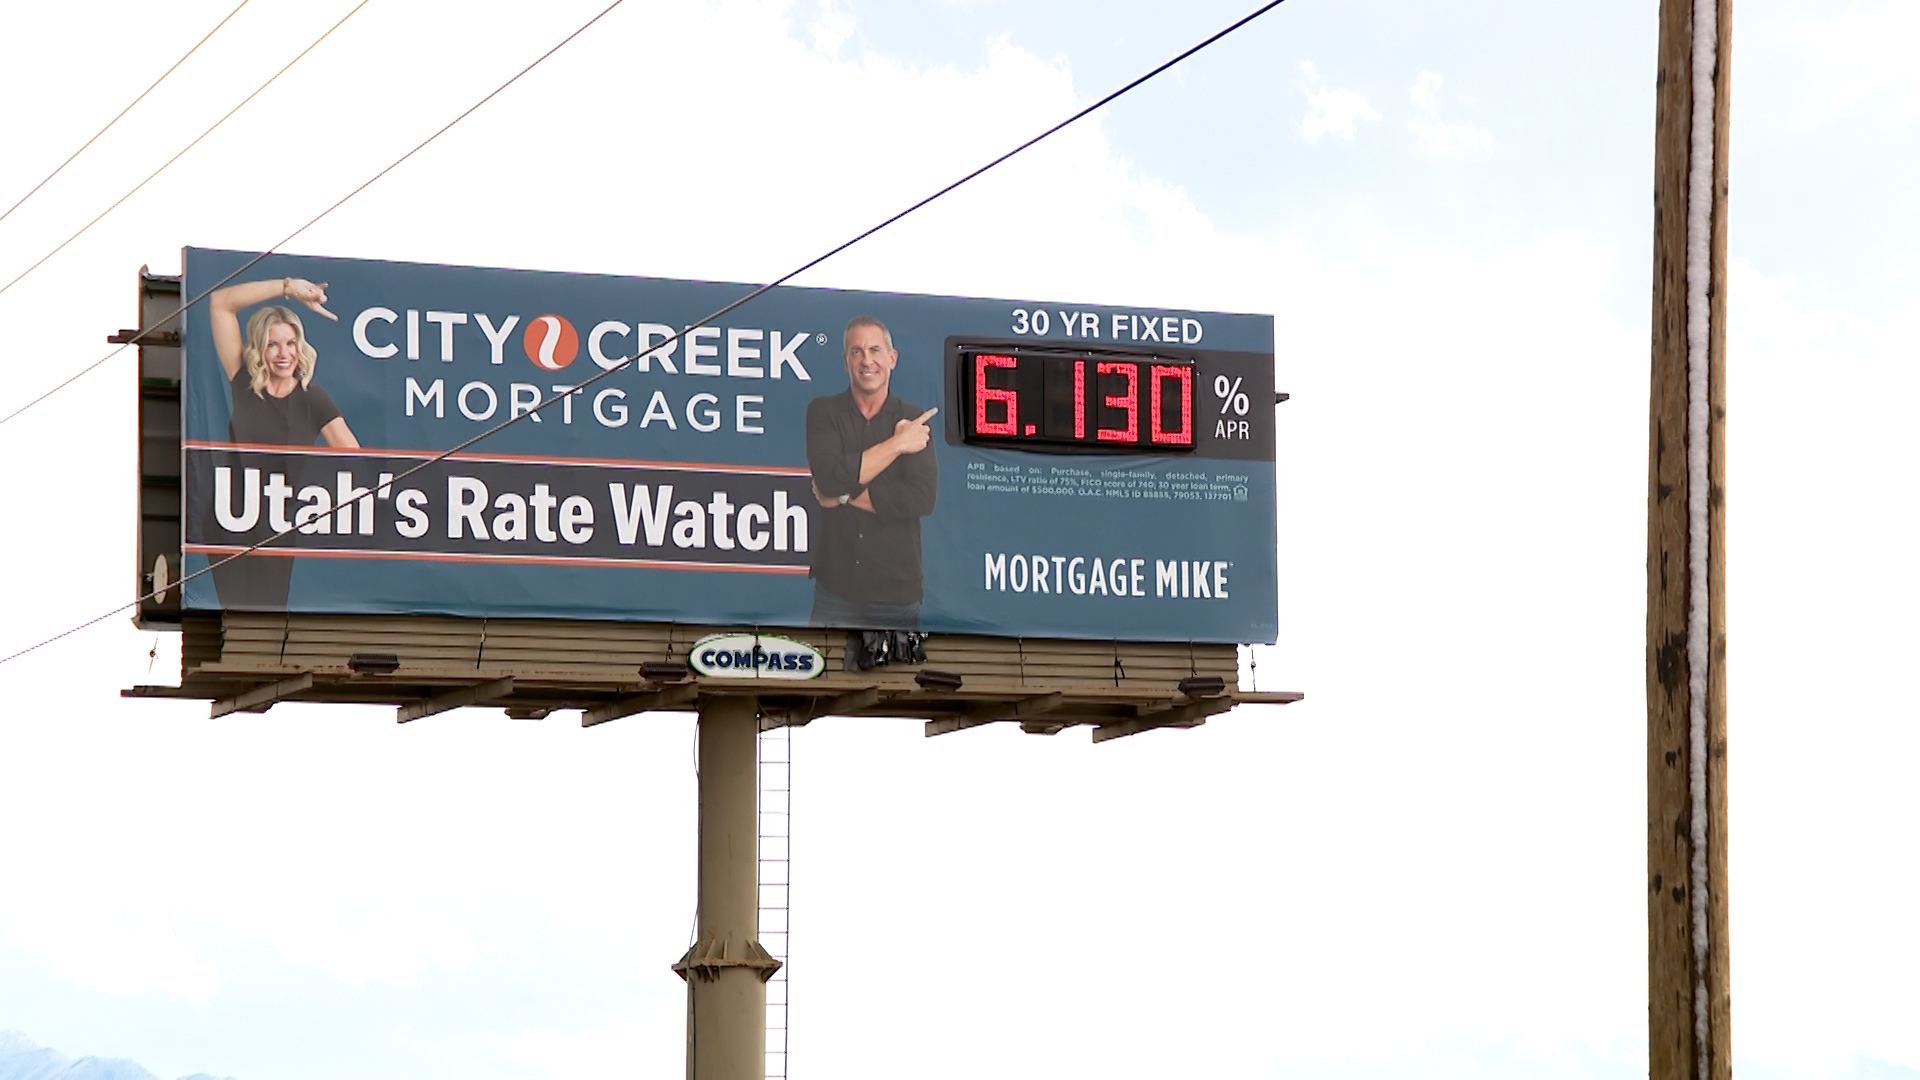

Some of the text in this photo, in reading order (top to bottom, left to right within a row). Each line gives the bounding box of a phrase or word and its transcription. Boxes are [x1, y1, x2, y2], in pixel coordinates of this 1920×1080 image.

[353, 307, 521, 365] CITY
[587, 320, 813, 381] CREEK
[1011, 307, 1203, 344] 30 YR FIXED
[404, 376, 766, 435] MORTGAGE
[975, 353, 1193, 445] 6.130
[1213, 374, 1250, 417] %
[1214, 419, 1250, 440] APR
[966, 461, 986, 472] APR
[993, 463, 1020, 473] based
[1215, 473, 1249, 483] primary
[966, 481, 986, 491] loan
[987, 484, 1019, 493] amount
[1020, 484, 1030, 494] of
[1105, 489, 1130, 498] NMLS
[1010, 475, 1027, 484] LTV
[1028, 475, 1048, 485] ratio
[1049, 477, 1059, 486] of
[1080, 478, 1102, 487] FICO
[1127, 480, 1137, 488] of
[1158, 481, 1170, 490] 30
[1170, 483, 1189, 491] year
[1190, 482, 1209, 490] loan
[213, 465, 809, 552] Utah's Rate Watch
[984, 552, 1230, 599] MORTGAGE MIKE
[701, 650, 814, 671] COMPASS
